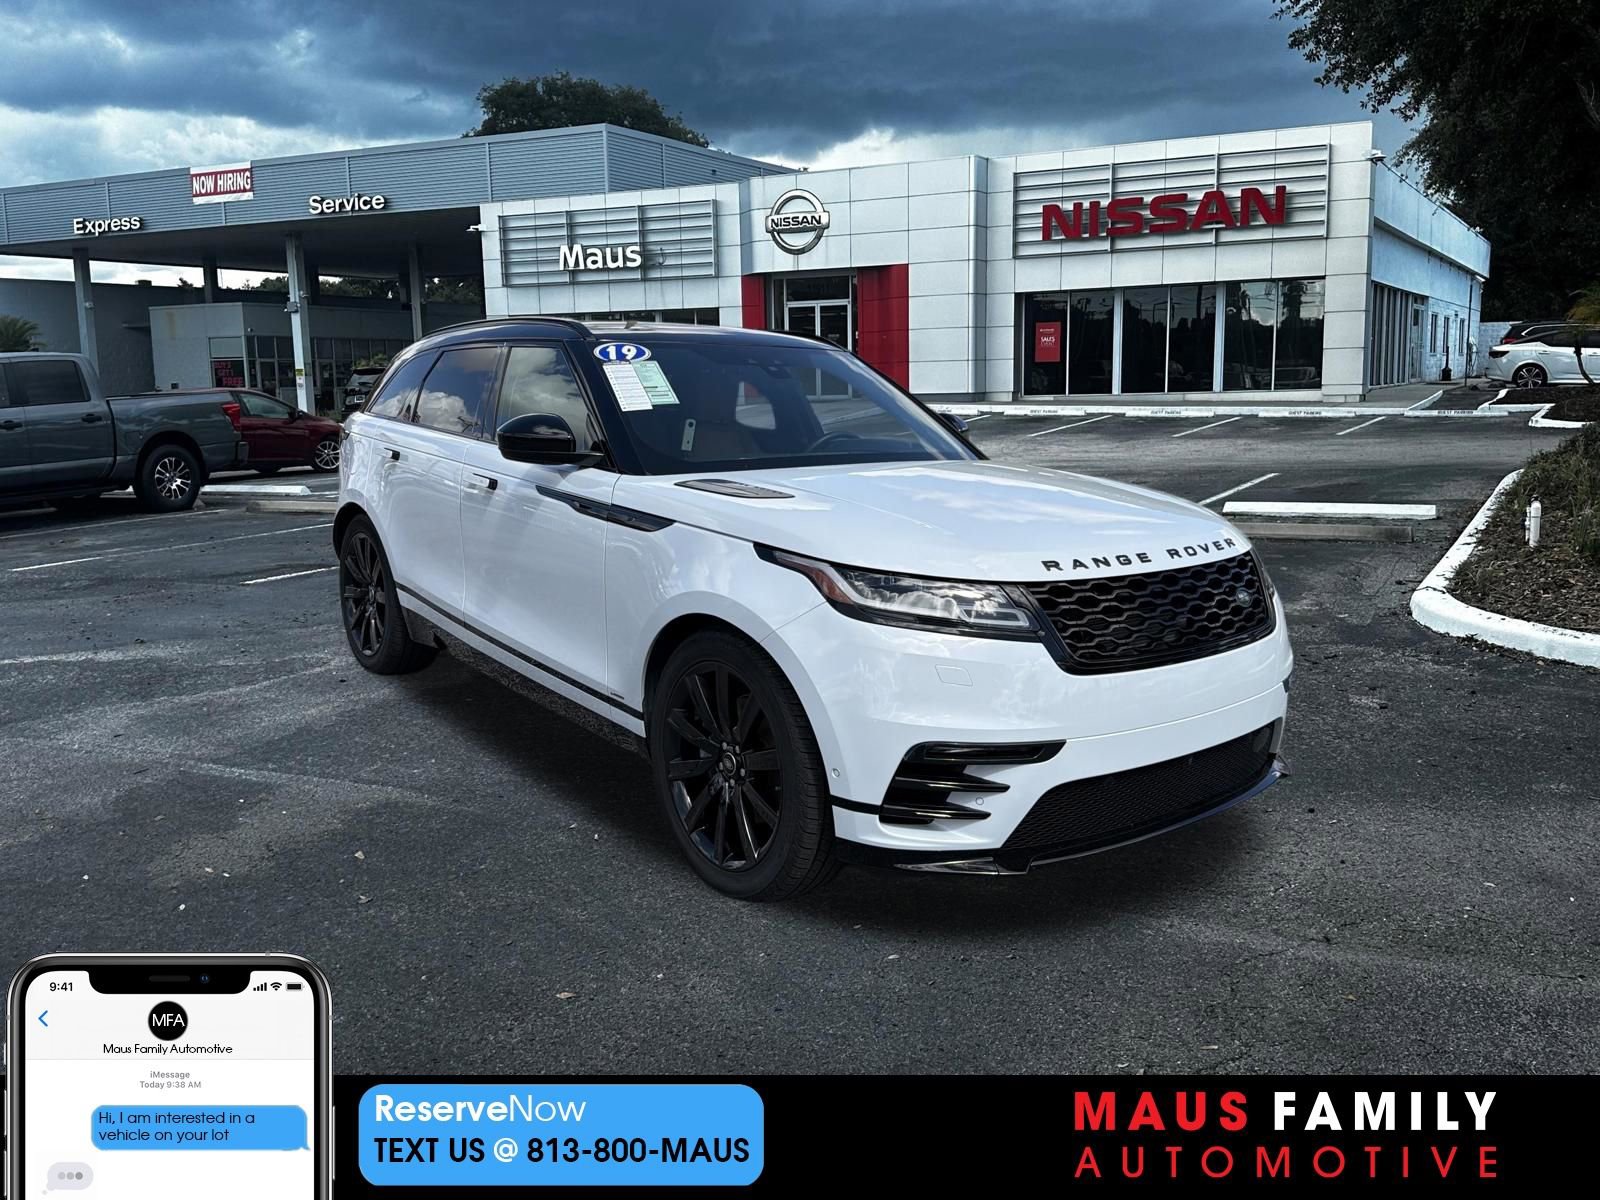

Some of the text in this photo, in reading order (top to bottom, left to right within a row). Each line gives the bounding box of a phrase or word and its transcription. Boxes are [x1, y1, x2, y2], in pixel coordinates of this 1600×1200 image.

[192, 171, 251, 195] NOW HIRING
[308, 193, 386, 215] Service
[1041, 185, 1287, 241] NISSAN
[72, 216, 141, 237] Express
[769, 213, 823, 229] NISSAN
[558, 242, 642, 271] Maus
[605, 345, 638, 360] 19
[1041, 537, 1237, 572] RANGE ROVER
